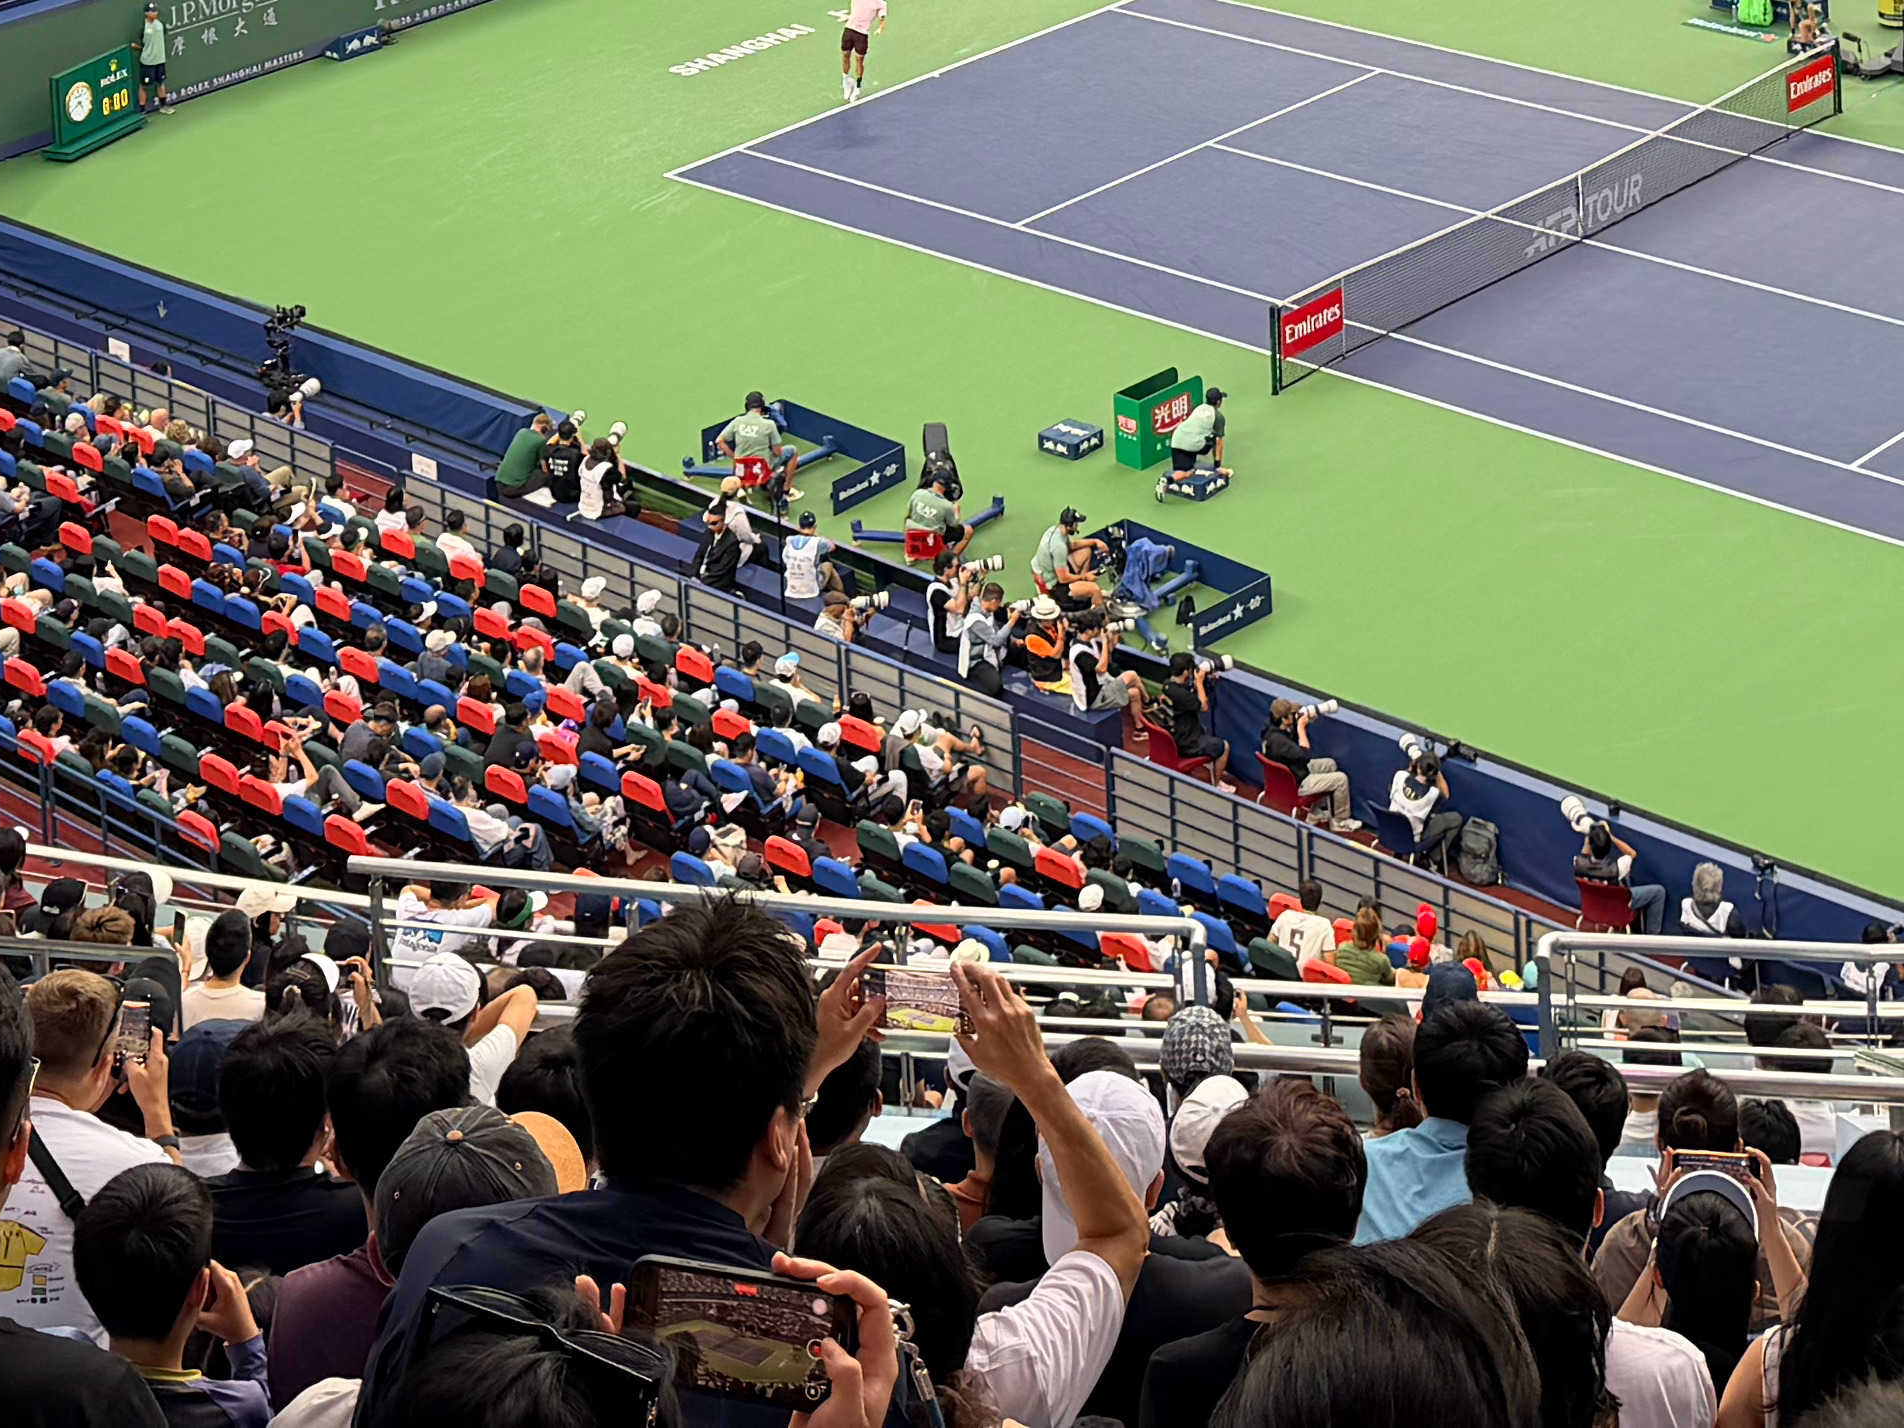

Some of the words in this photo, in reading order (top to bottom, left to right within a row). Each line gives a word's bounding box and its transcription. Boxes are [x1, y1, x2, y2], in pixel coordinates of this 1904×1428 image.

[669, 23, 816, 77] SHANGHAI
[180, 80, 211, 98] ROLEX
[212, 63, 262, 87] SHANGHAI
[264, 49, 304, 74] MASTERS
[1790, 68, 1833, 100] Emirates
[1523, 204, 1578, 259] ATP
[1584, 173, 1643, 227] TOUR
[1286, 301, 1342, 345] Emirates
[1153, 395, 1189, 429] 光明
